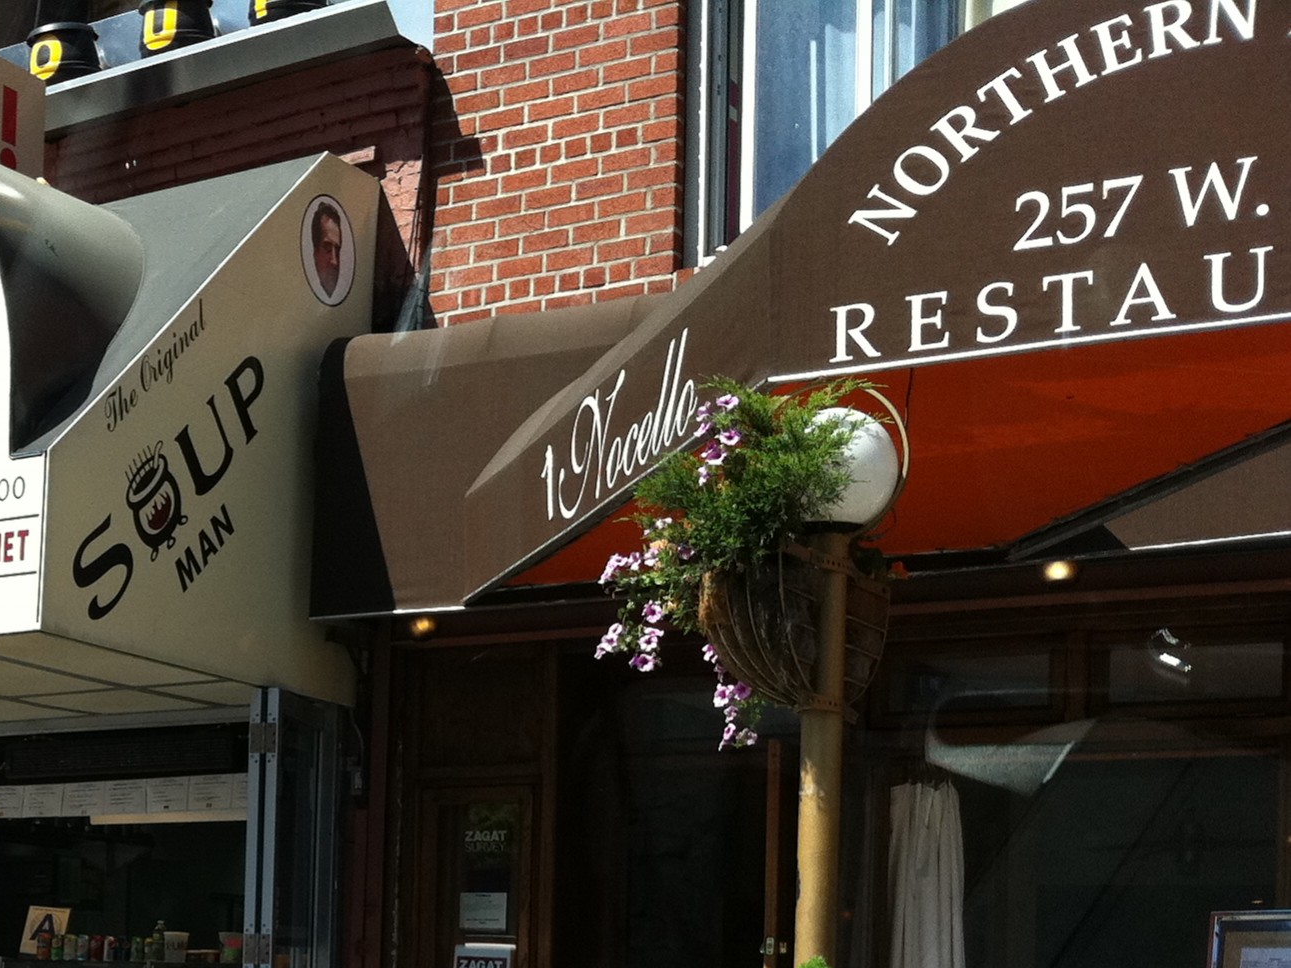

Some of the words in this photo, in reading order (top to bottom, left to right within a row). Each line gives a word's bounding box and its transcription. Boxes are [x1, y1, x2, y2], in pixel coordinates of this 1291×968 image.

[848, 0, 1259, 247] NORTHERN
[1013, 175, 1144, 251] 257
[1168, 156, 1270, 228] W.
[829, 246, 1274, 364] RESTAU
[103, 385, 139, 434] The
[139, 298, 206, 393] Original
[72, 355, 265, 621] SOUP
[174, 503, 236, 592] MAN
[464, 830, 508, 842] ZAGAT
